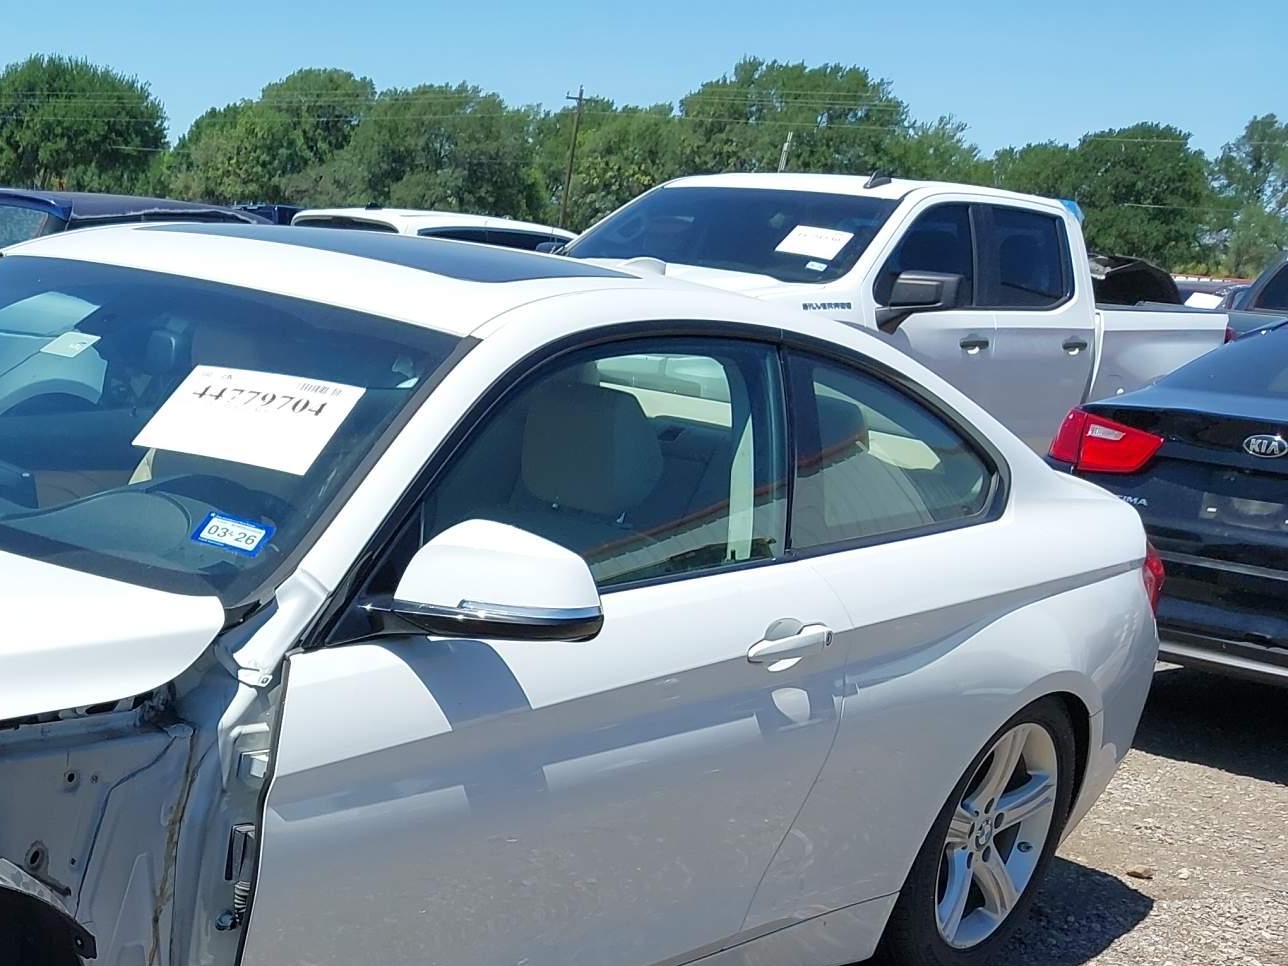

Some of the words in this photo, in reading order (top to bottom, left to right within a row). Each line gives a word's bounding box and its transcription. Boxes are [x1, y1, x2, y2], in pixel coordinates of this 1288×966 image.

[192, 385, 328, 417] 44779704
[1249, 438, 1280, 455] KIA
[207, 524, 229, 538] 03
[234, 532, 257, 545] 26
